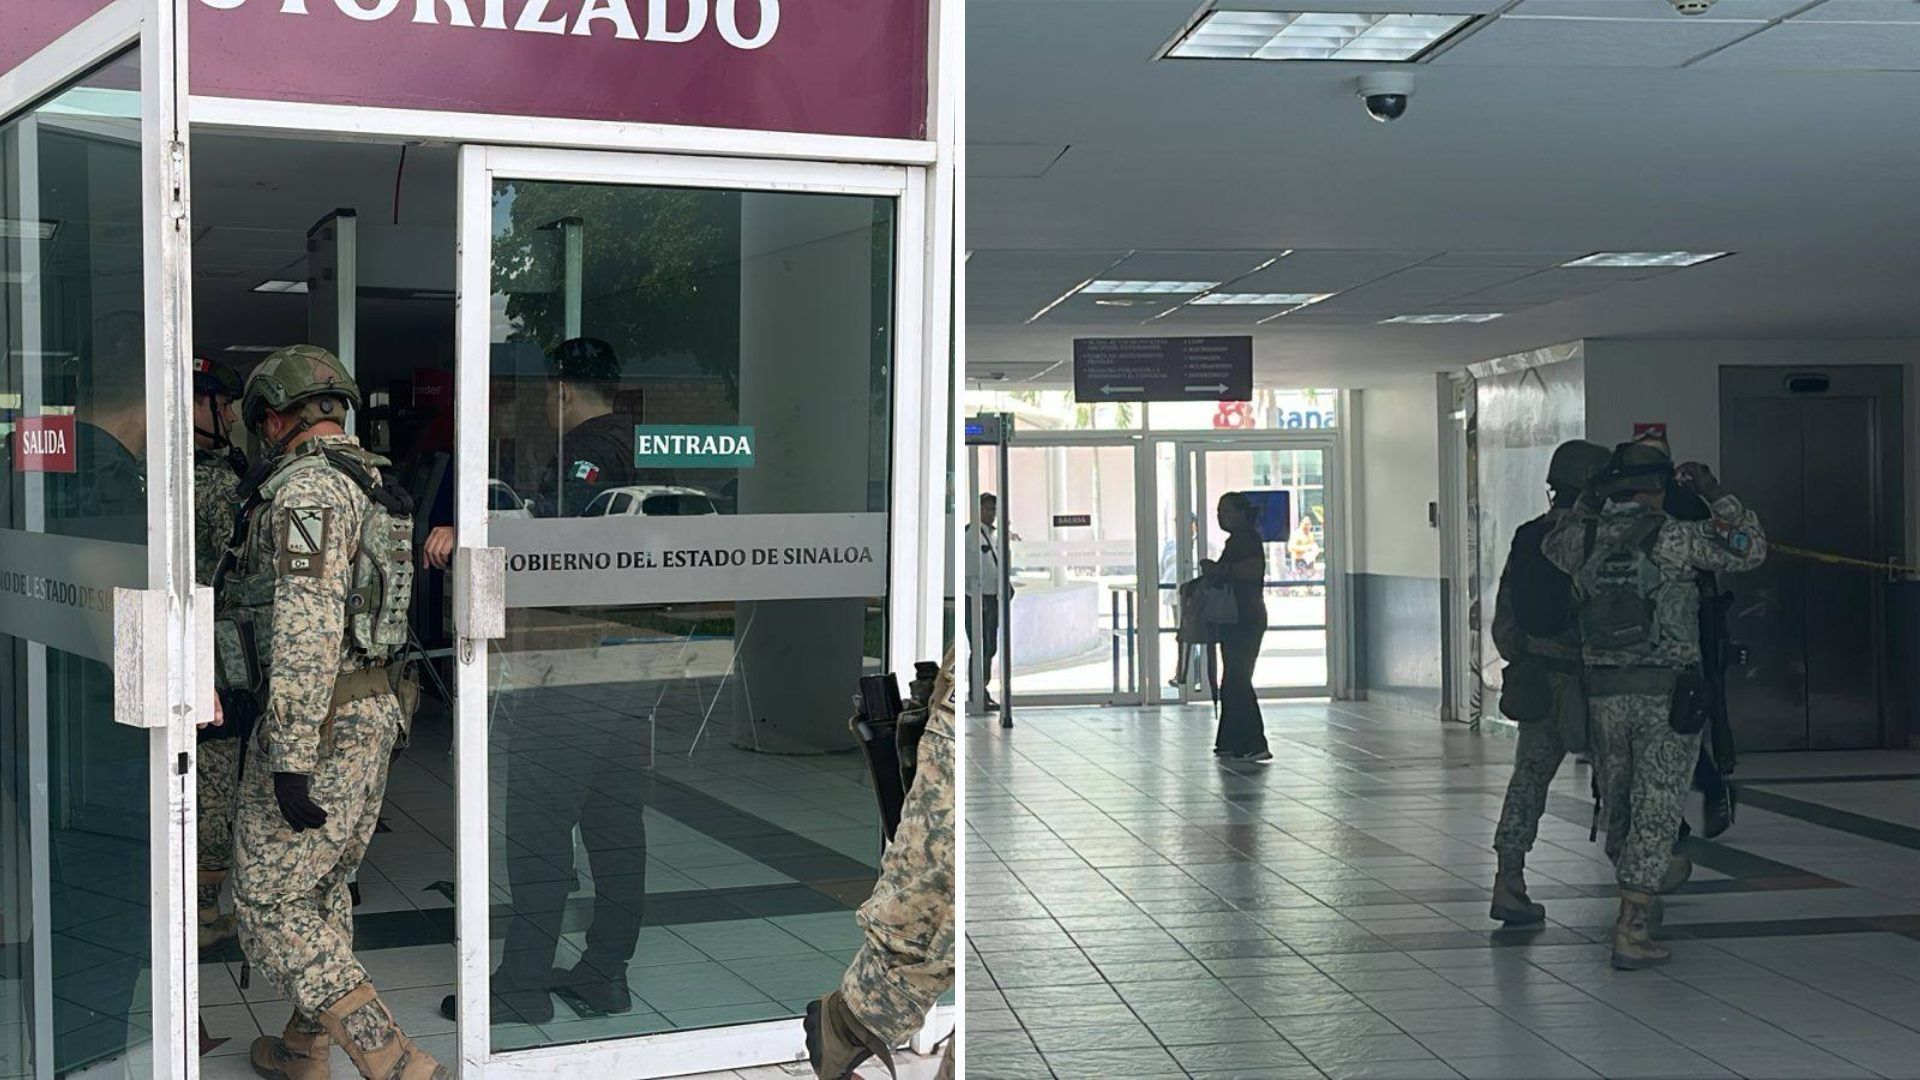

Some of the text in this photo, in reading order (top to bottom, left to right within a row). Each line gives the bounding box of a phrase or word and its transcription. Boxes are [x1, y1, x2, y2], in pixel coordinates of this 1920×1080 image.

[22, 429, 66, 455] SALIDA
[638, 434, 752, 455] ENTRADA
[505, 546, 874, 572] OBIERNO DEL ESTADO DE SINALOA
[12, 571, 32, 597] DEL
[33, 577, 77, 606] ESTADO
